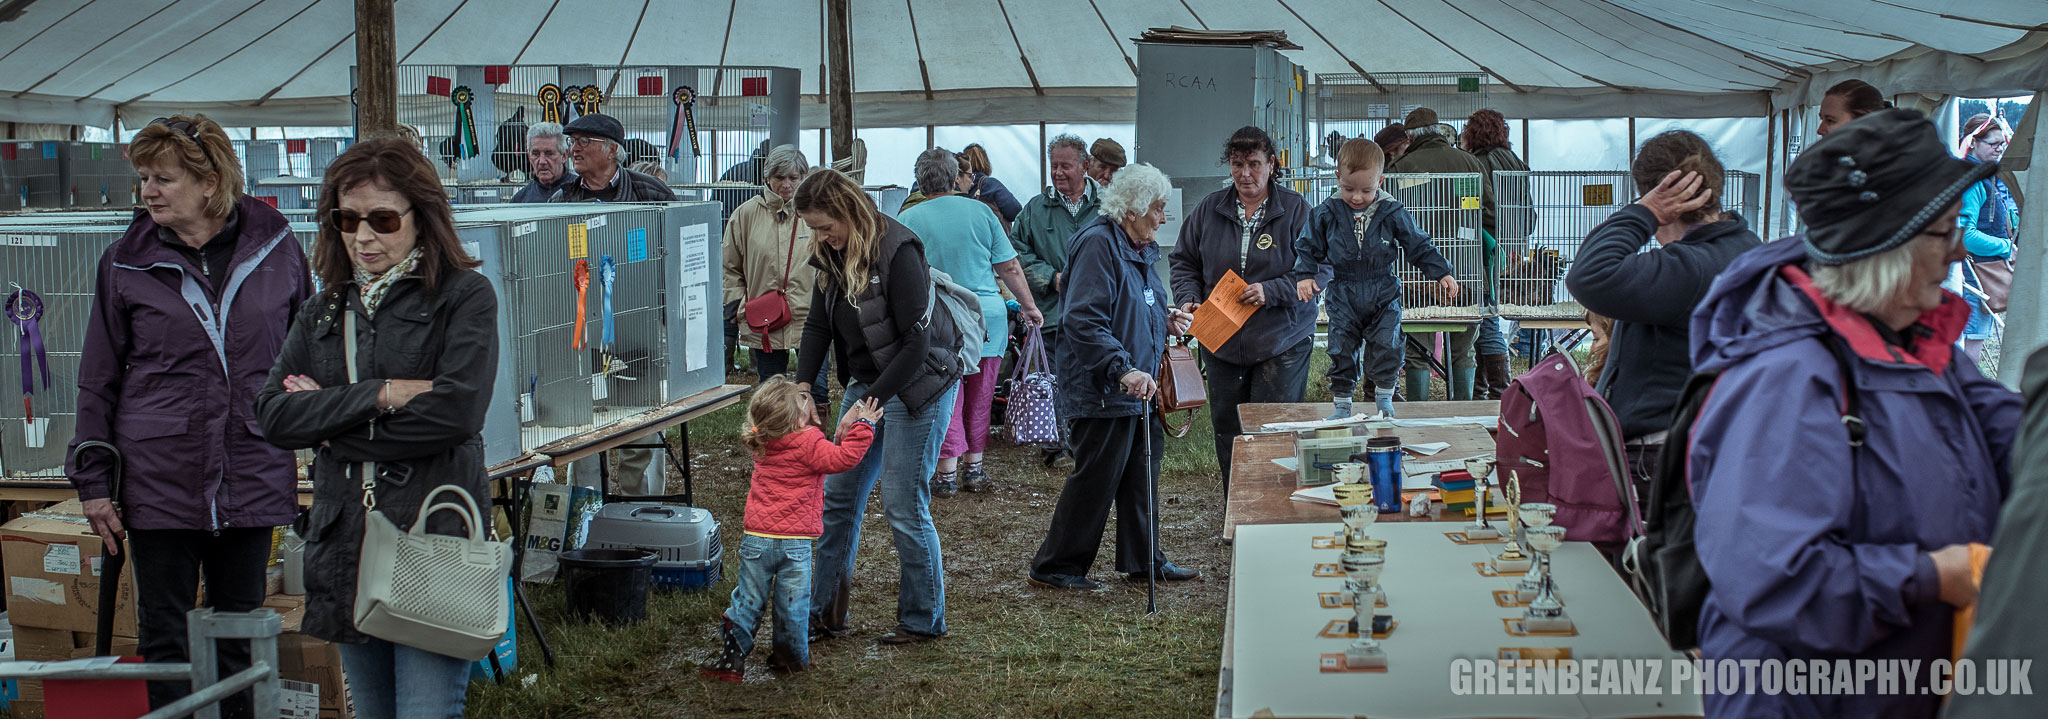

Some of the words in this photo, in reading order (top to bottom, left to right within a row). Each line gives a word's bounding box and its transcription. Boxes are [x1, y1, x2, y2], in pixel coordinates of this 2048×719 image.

[1165, 72, 1217, 93] RCAA
[11, 236, 23, 245] 121
[528, 534, 561, 552] M&G
